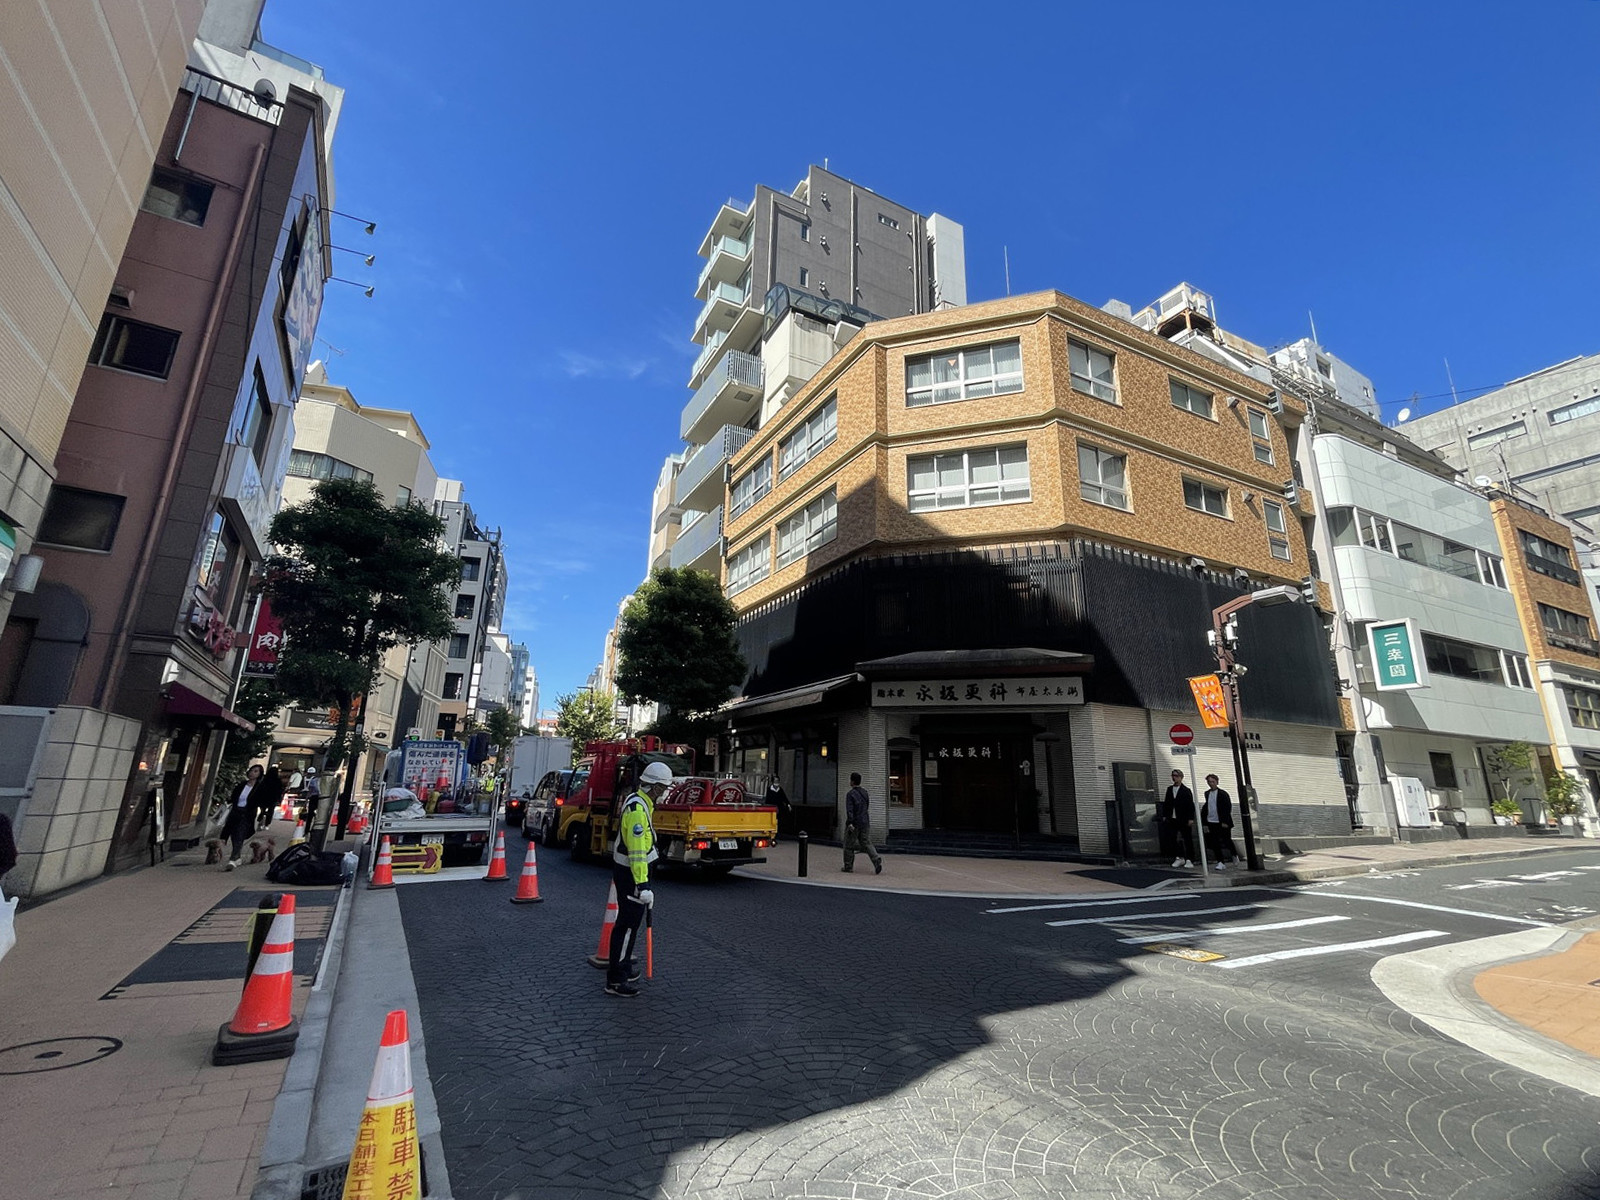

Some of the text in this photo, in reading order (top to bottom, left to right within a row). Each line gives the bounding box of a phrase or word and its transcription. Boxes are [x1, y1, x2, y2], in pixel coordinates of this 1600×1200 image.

[349, 1111, 380, 1200] 本日舗装工
